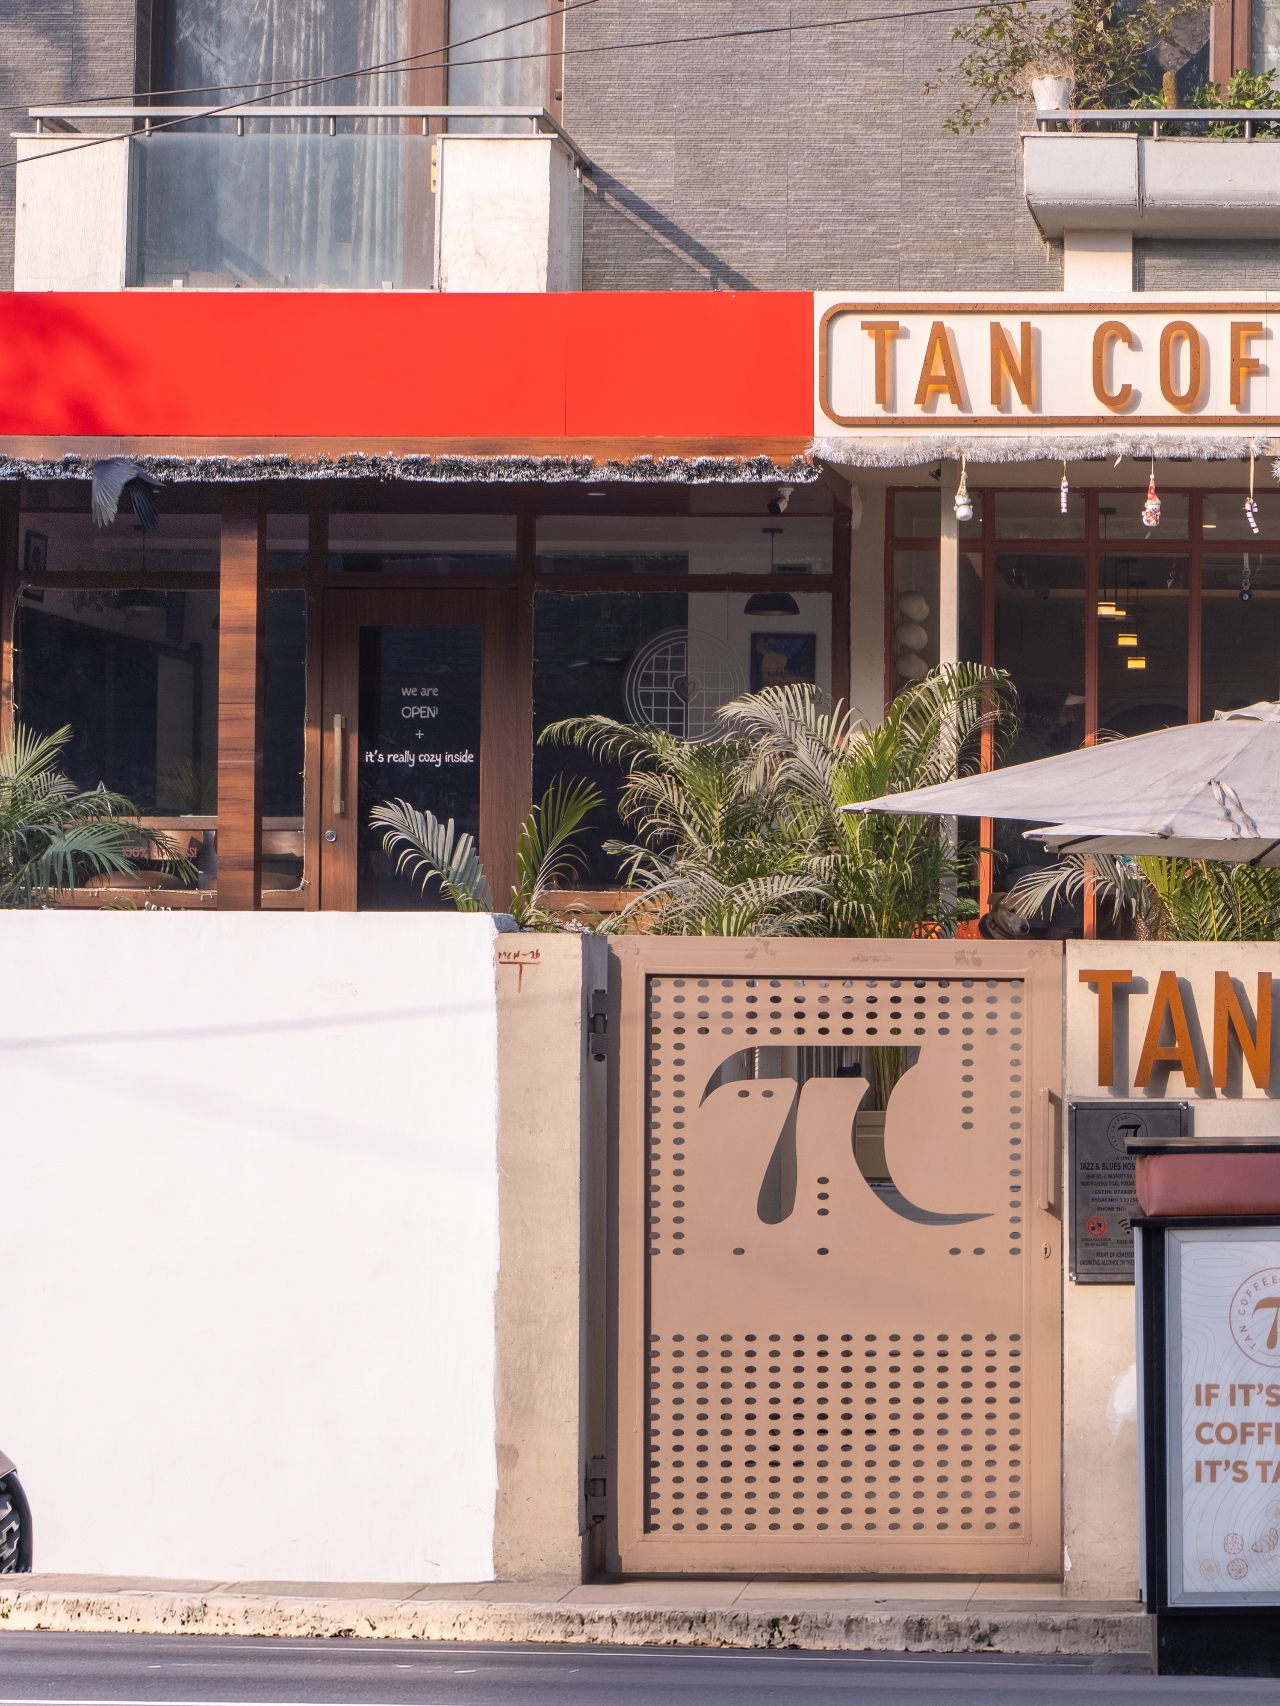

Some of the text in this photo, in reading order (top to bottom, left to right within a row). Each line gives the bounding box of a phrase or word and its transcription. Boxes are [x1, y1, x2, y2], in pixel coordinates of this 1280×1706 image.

[859, 320, 1033, 406] TAN
[401, 687, 439, 697] we are
[365, 749, 474, 768] it's really cozy inside
[1078, 969, 1273, 1089] TAN
[1080, 1162, 1136, 1170] JAZZ & BLUES HOS
[1238, 1275, 1278, 1350] TAN COFFEE
[1195, 1383, 1220, 1407] IF
[1195, 1459, 1249, 1483] IT'S
